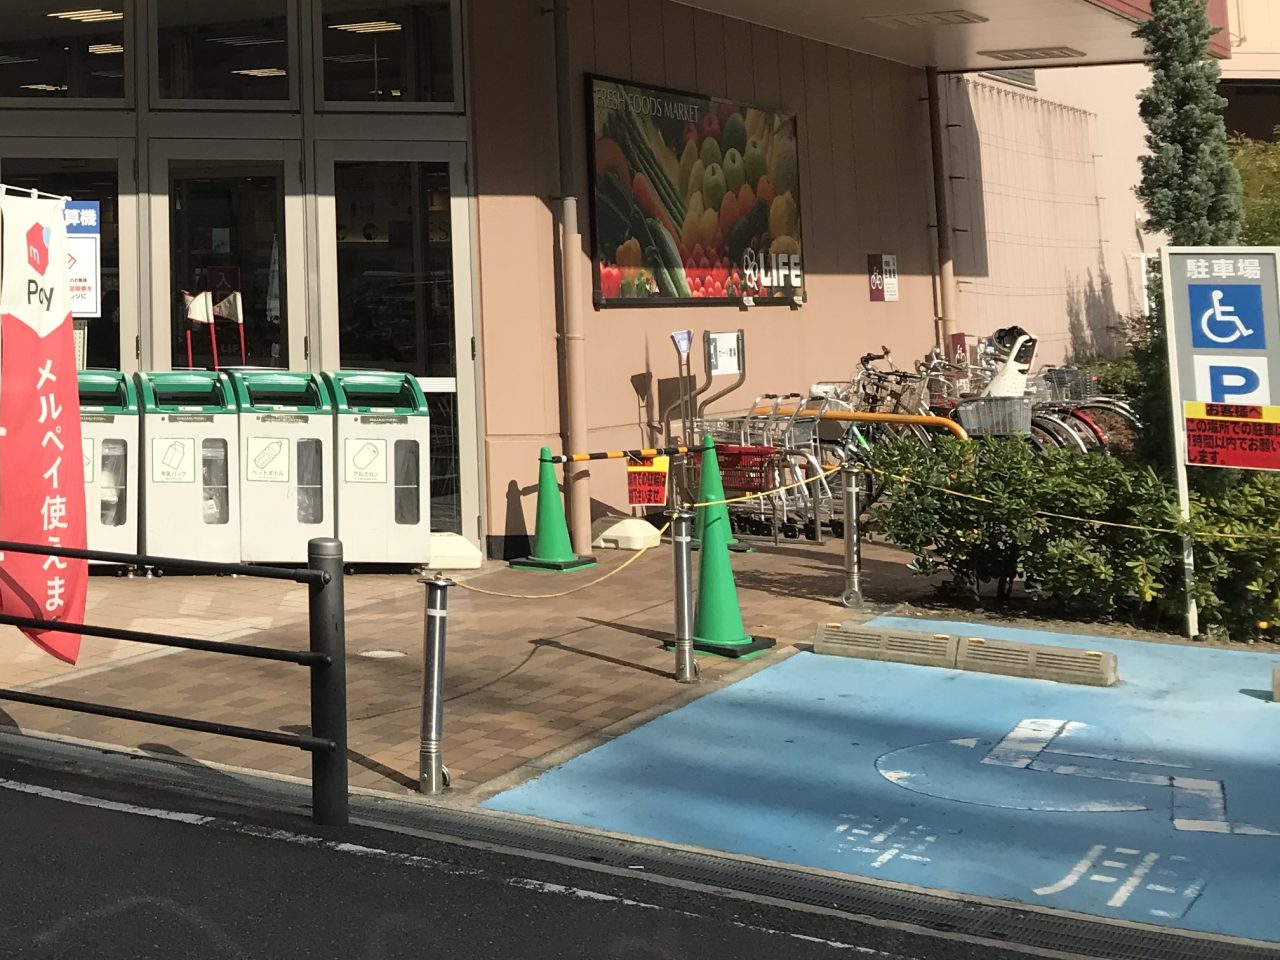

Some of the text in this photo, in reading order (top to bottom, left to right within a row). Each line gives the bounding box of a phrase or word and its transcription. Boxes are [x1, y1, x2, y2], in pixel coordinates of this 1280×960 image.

[595, 88, 699, 122] FRESH FOODS MARKET
[759, 252, 802, 288] LIFE
[1186, 259, 1261, 280] 駐車場
[27, 279, 54, 311] Pay
[1206, 403, 1262, 418] お客様へ
